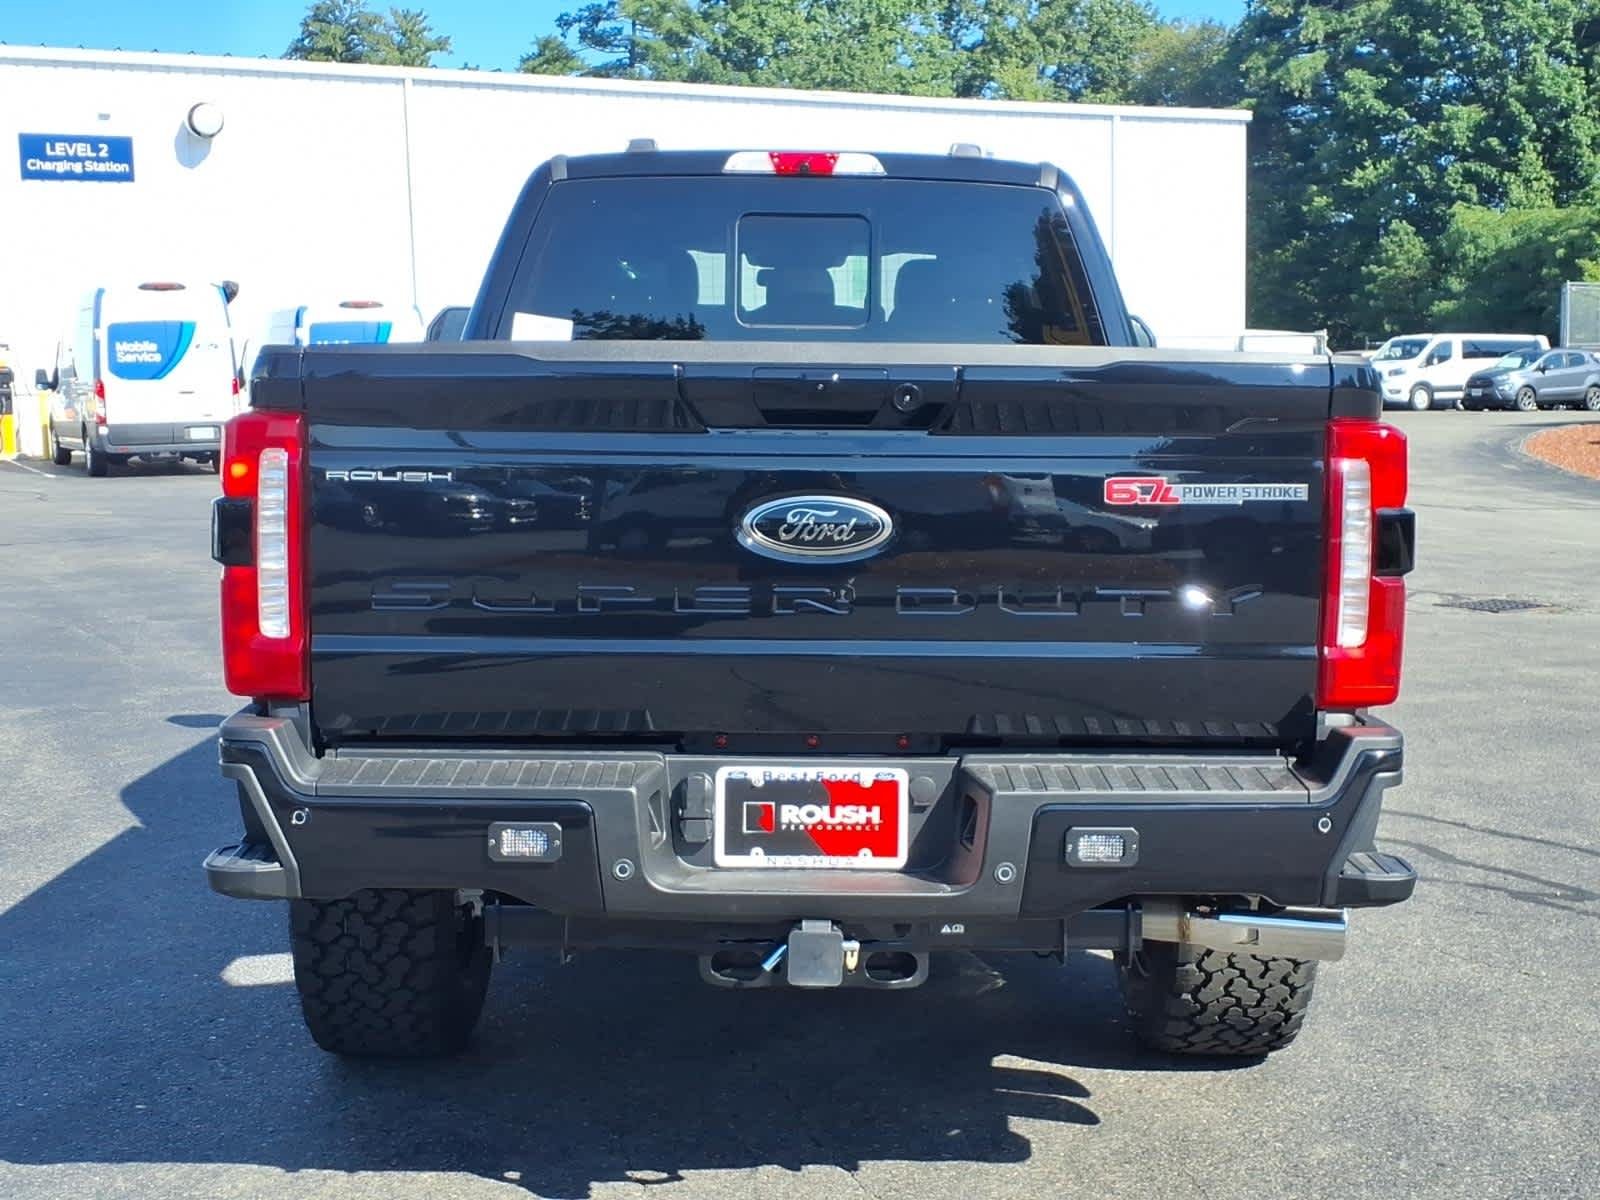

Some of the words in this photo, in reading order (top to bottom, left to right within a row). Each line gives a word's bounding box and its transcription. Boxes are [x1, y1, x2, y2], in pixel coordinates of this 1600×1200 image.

[45, 142, 97, 157] LEVEL
[98, 143, 109, 158] 2
[26, 158, 83, 173] Charging
[84, 160, 129, 173] Station
[115, 341, 158, 352] Mobile
[116, 352, 162, 363] Service
[325, 470, 452, 482] ROUSH
[1182, 486, 1237, 499] POWER
[1242, 487, 1302, 500] STROKE
[778, 508, 858, 542] Ford
[370, 578, 851, 616] SUPER
[896, 584, 1264, 617] DUTY
[763, 770, 810, 783] Best
[816, 771, 861, 785] Ford
[780, 804, 881, 825] ROUSH
[781, 824, 880, 832] PERFORMANCE
[766, 856, 855, 866] NASHUA
